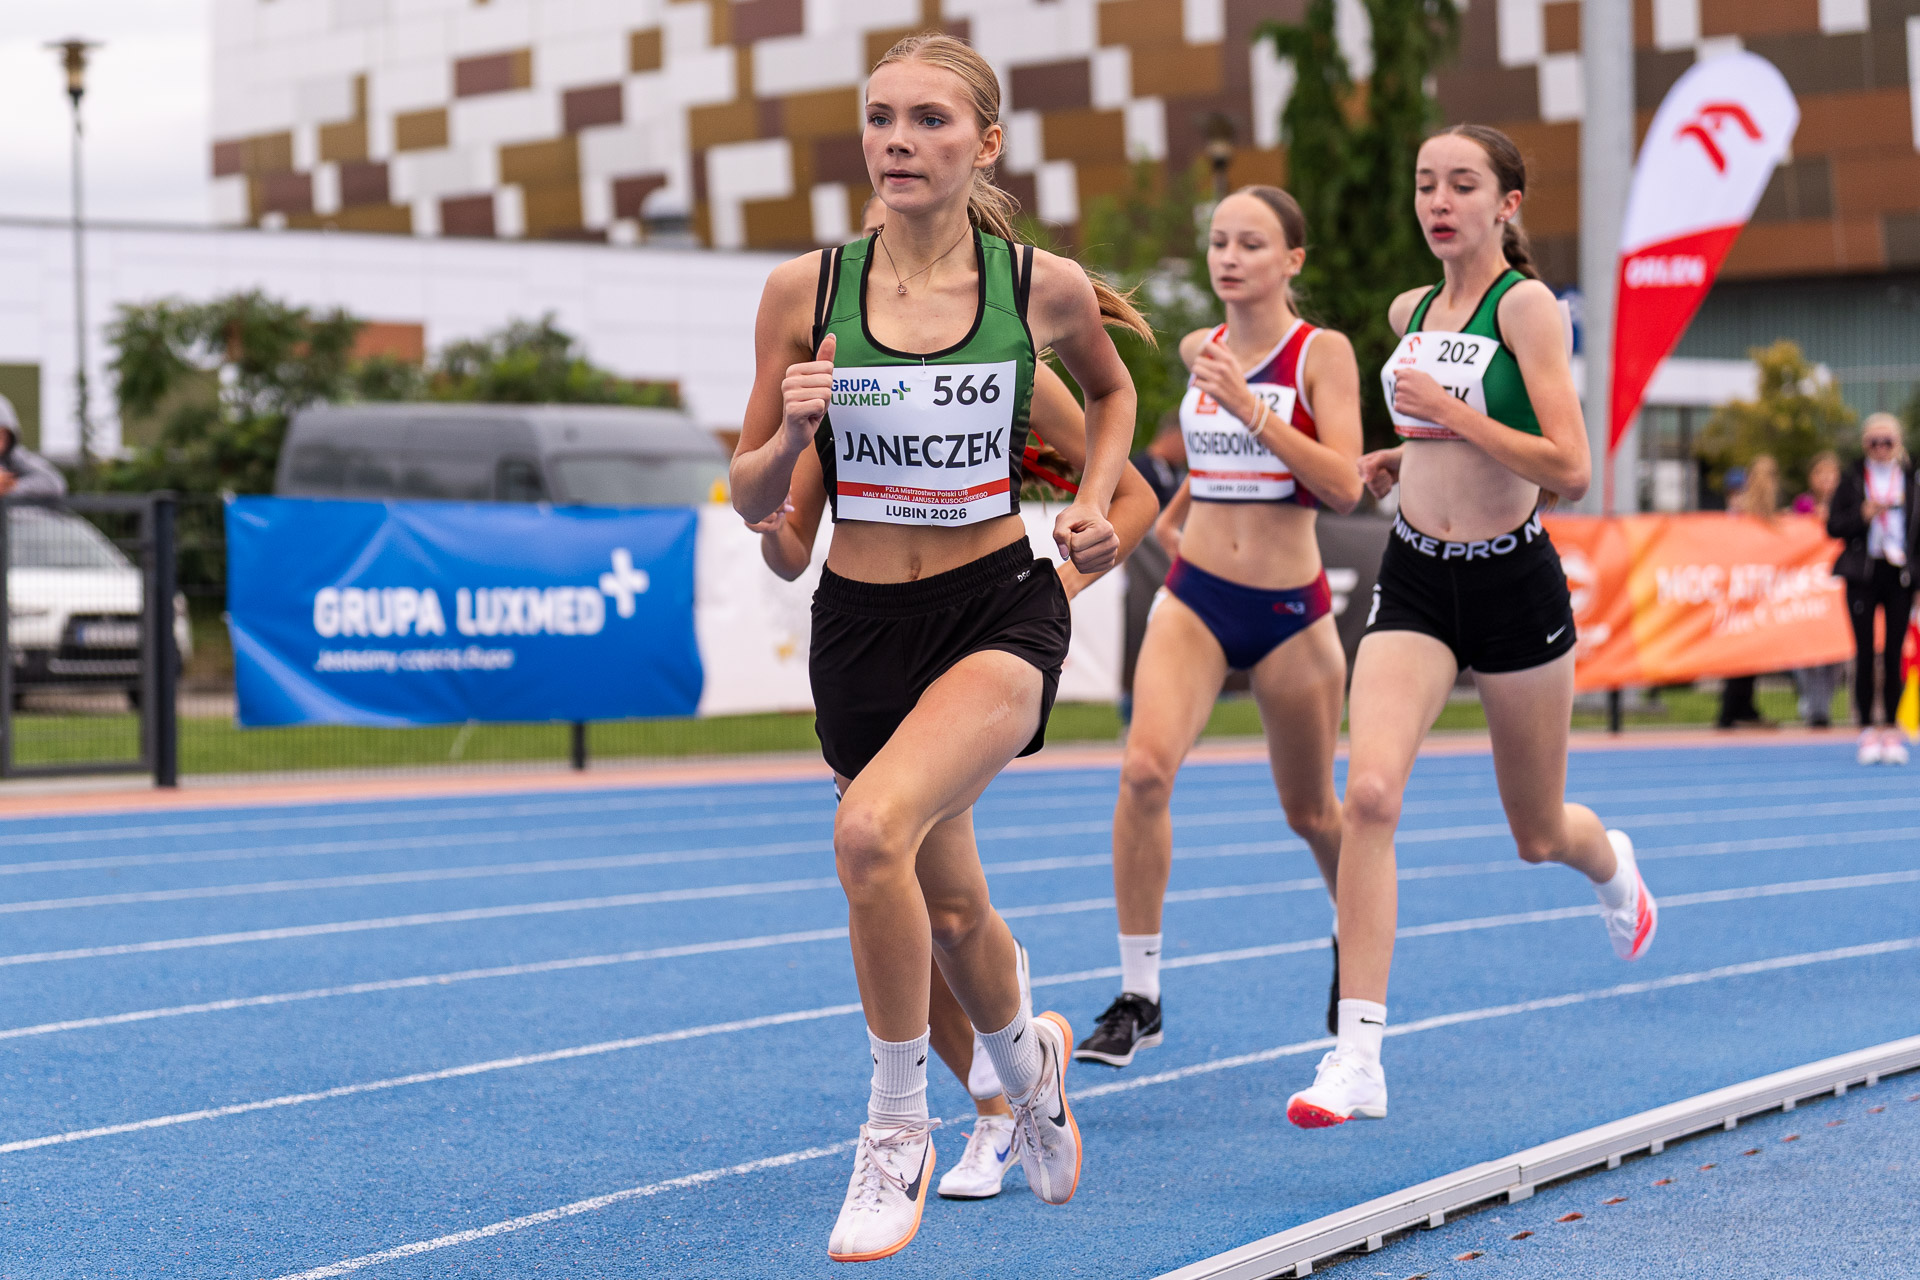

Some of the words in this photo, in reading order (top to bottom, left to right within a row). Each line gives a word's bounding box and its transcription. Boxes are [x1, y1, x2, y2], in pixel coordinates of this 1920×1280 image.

[1437, 340, 1480, 365] 202
[831, 393, 891, 406] LUXMED
[933, 373, 1000, 406] 566
[843, 427, 1005, 469] JANECZEK
[900, 487, 936, 497] Mistrzostwa
[937, 489, 957, 498] Polski
[911, 495, 940, 504] JANUSZA
[886, 504, 927, 519] LUBIN
[930, 507, 967, 520] 2026
[1393, 511, 1439, 557] NIKE
[1441, 534, 1518, 561] PRO
[313, 586, 446, 638] GRUPA
[456, 586, 606, 637] LUXMED
